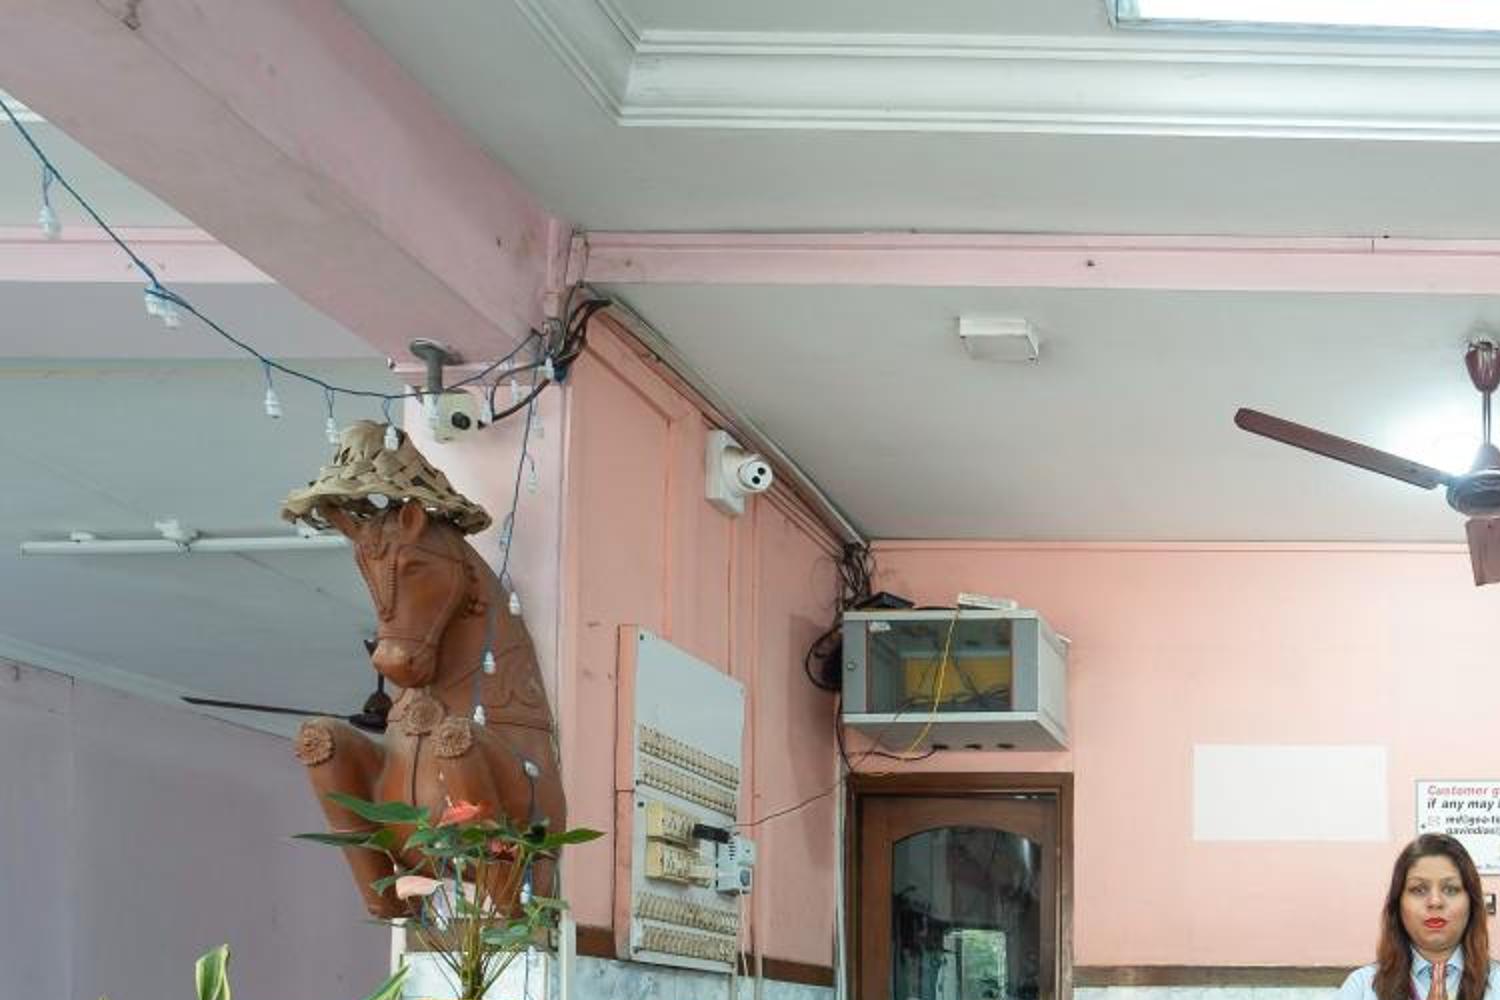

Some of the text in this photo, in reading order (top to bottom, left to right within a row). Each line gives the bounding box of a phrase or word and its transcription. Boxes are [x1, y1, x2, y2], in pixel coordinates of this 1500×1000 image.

[1427, 785, 1488, 796] Customer
[1427, 798, 1437, 809] if
[1441, 800, 1465, 811] any
[1467, 800, 1495, 811] may
